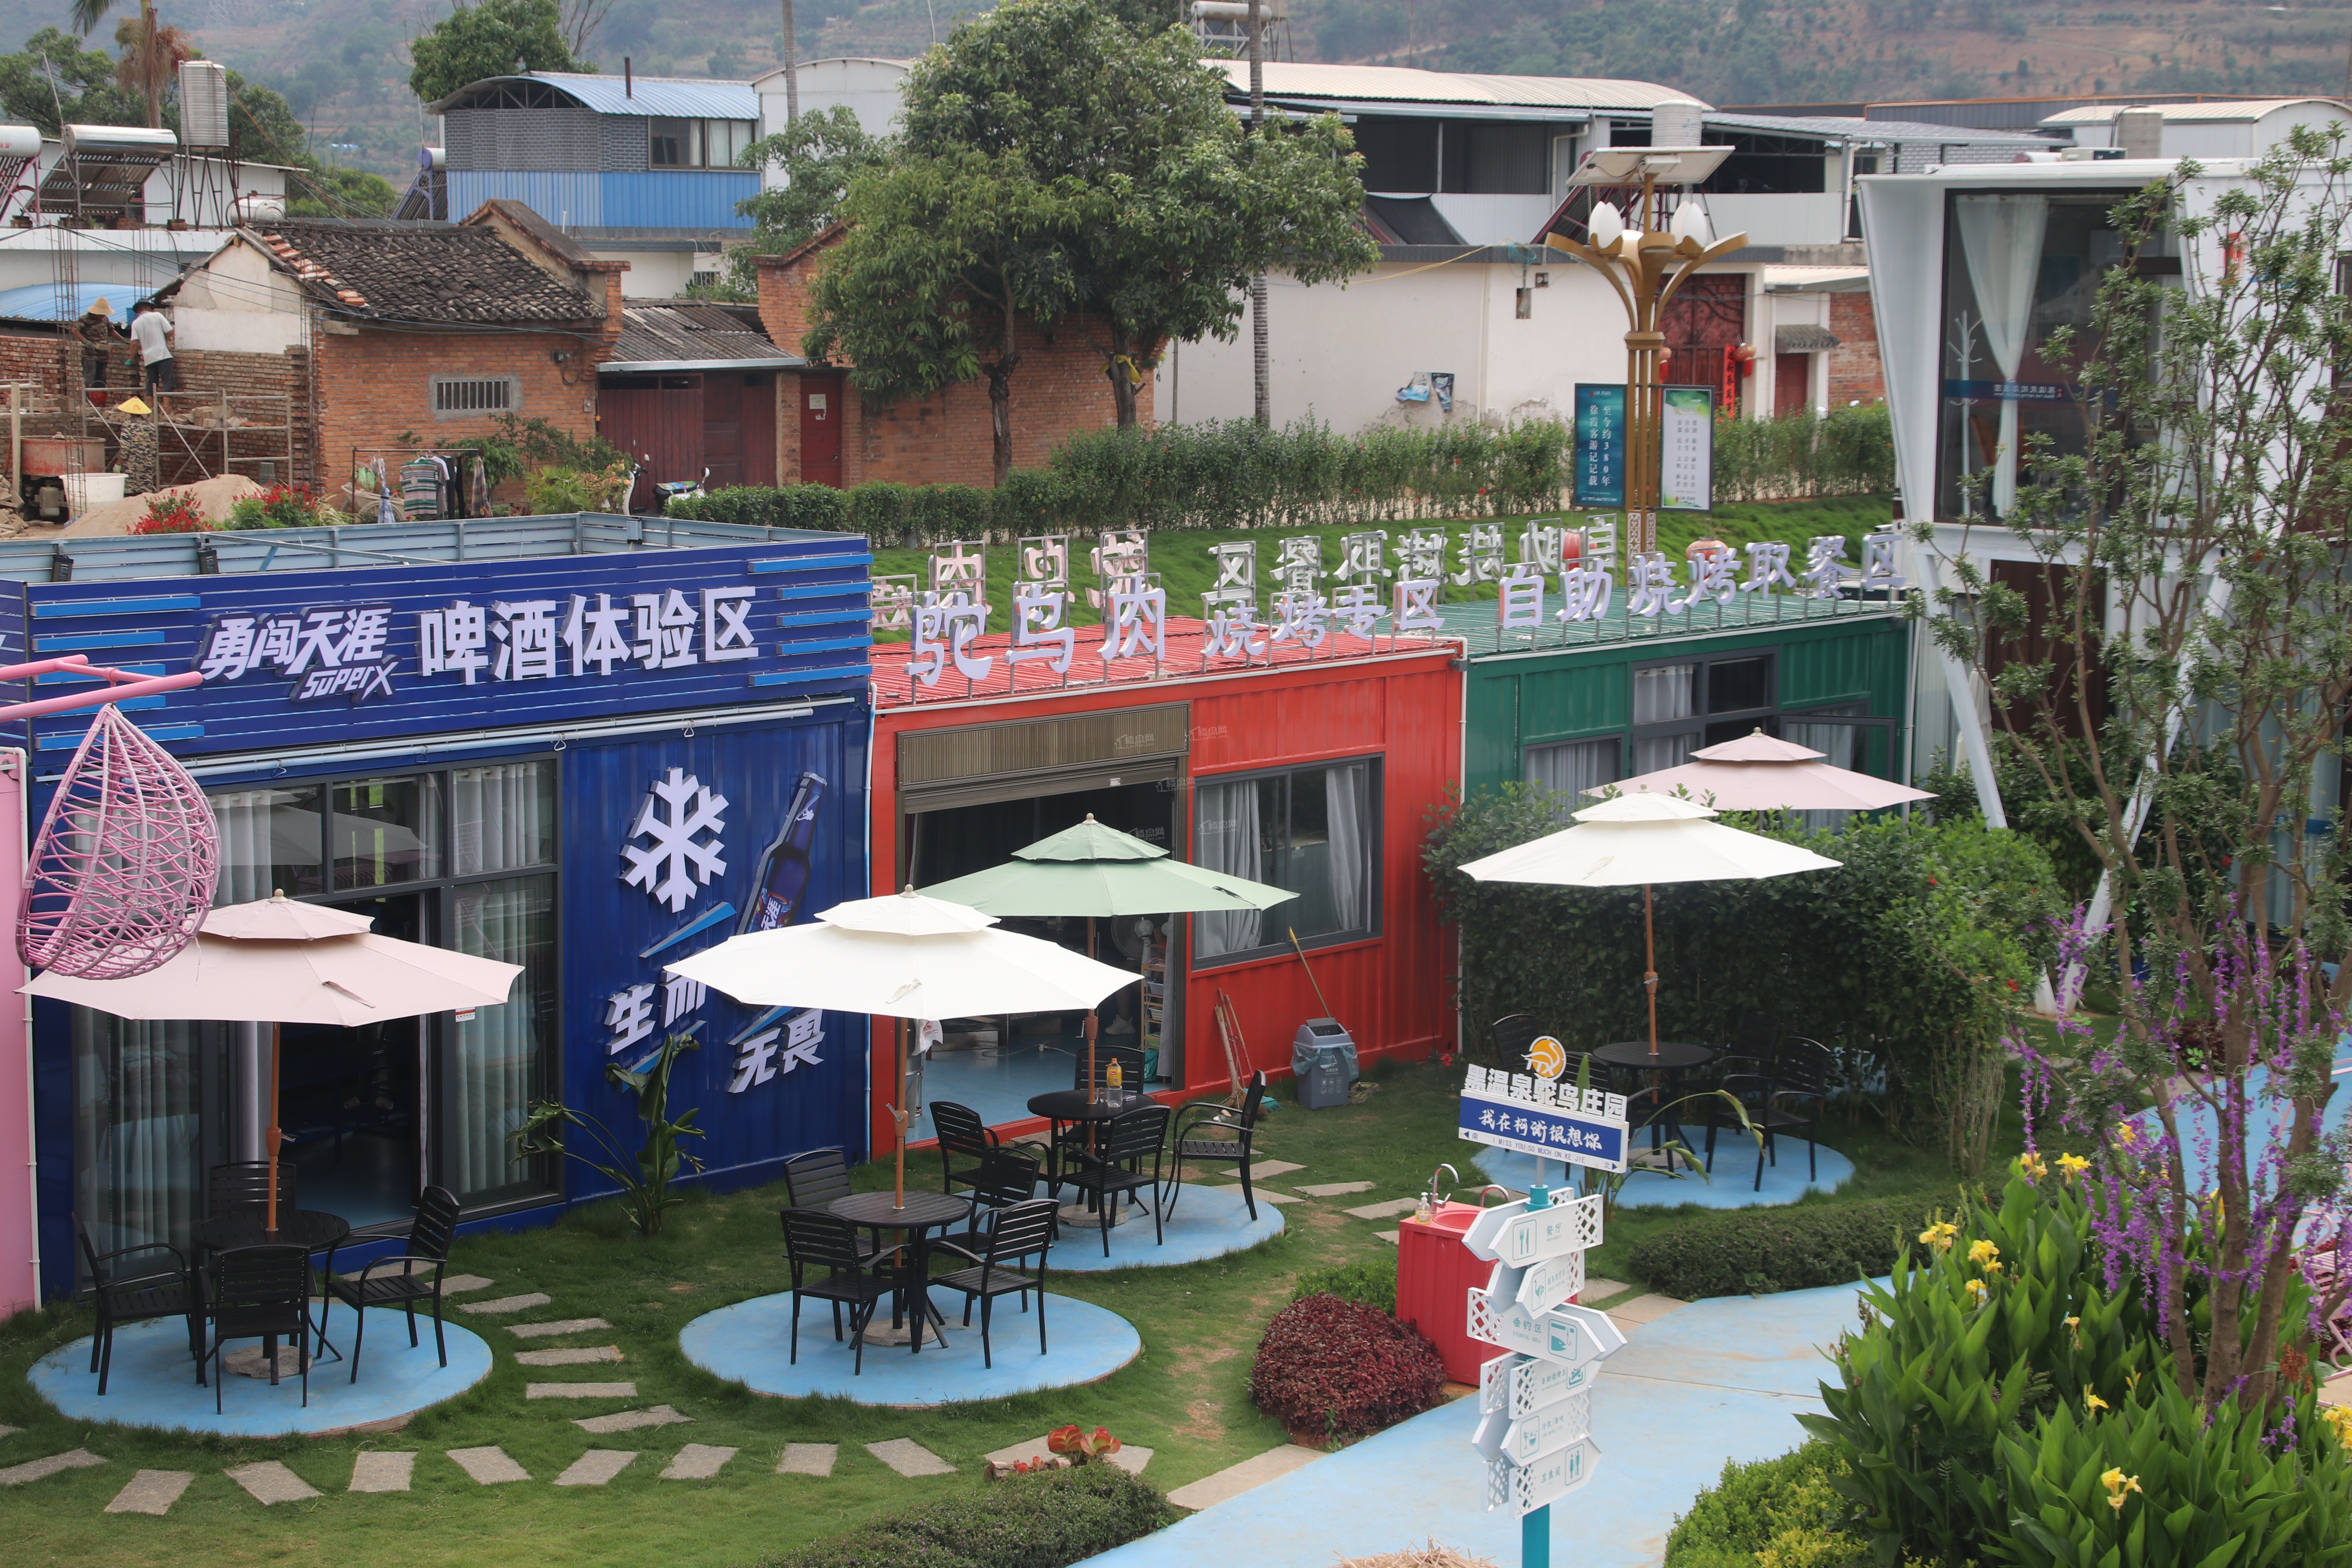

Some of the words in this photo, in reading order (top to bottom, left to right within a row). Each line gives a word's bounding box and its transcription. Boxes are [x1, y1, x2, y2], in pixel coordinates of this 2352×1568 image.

[1588, 405, 1599, 486] 徐霞客游记记载
[1499, 533, 1909, 629] 自助烧烤取餐区
[202, 606, 390, 682] 勇闯天涯
[419, 586, 760, 685] 啤酒体验区
[728, 1008, 825, 1093] 无畏
[1472, 1132, 1479, 1141] 南
[1479, 1109, 1602, 1151] 我在柯街很想你
[1498, 1139, 1512, 1147] MISS
[1515, 1142, 1525, 1150] YOU
[1538, 1147, 1552, 1156] MUCH
[1546, 1223, 1561, 1236] 餐厅
[1512, 1317, 1542, 1333] 垂钓区
[1513, 1331, 1529, 1340] FISHING
[1541, 1466, 1560, 1483] 卫生间
